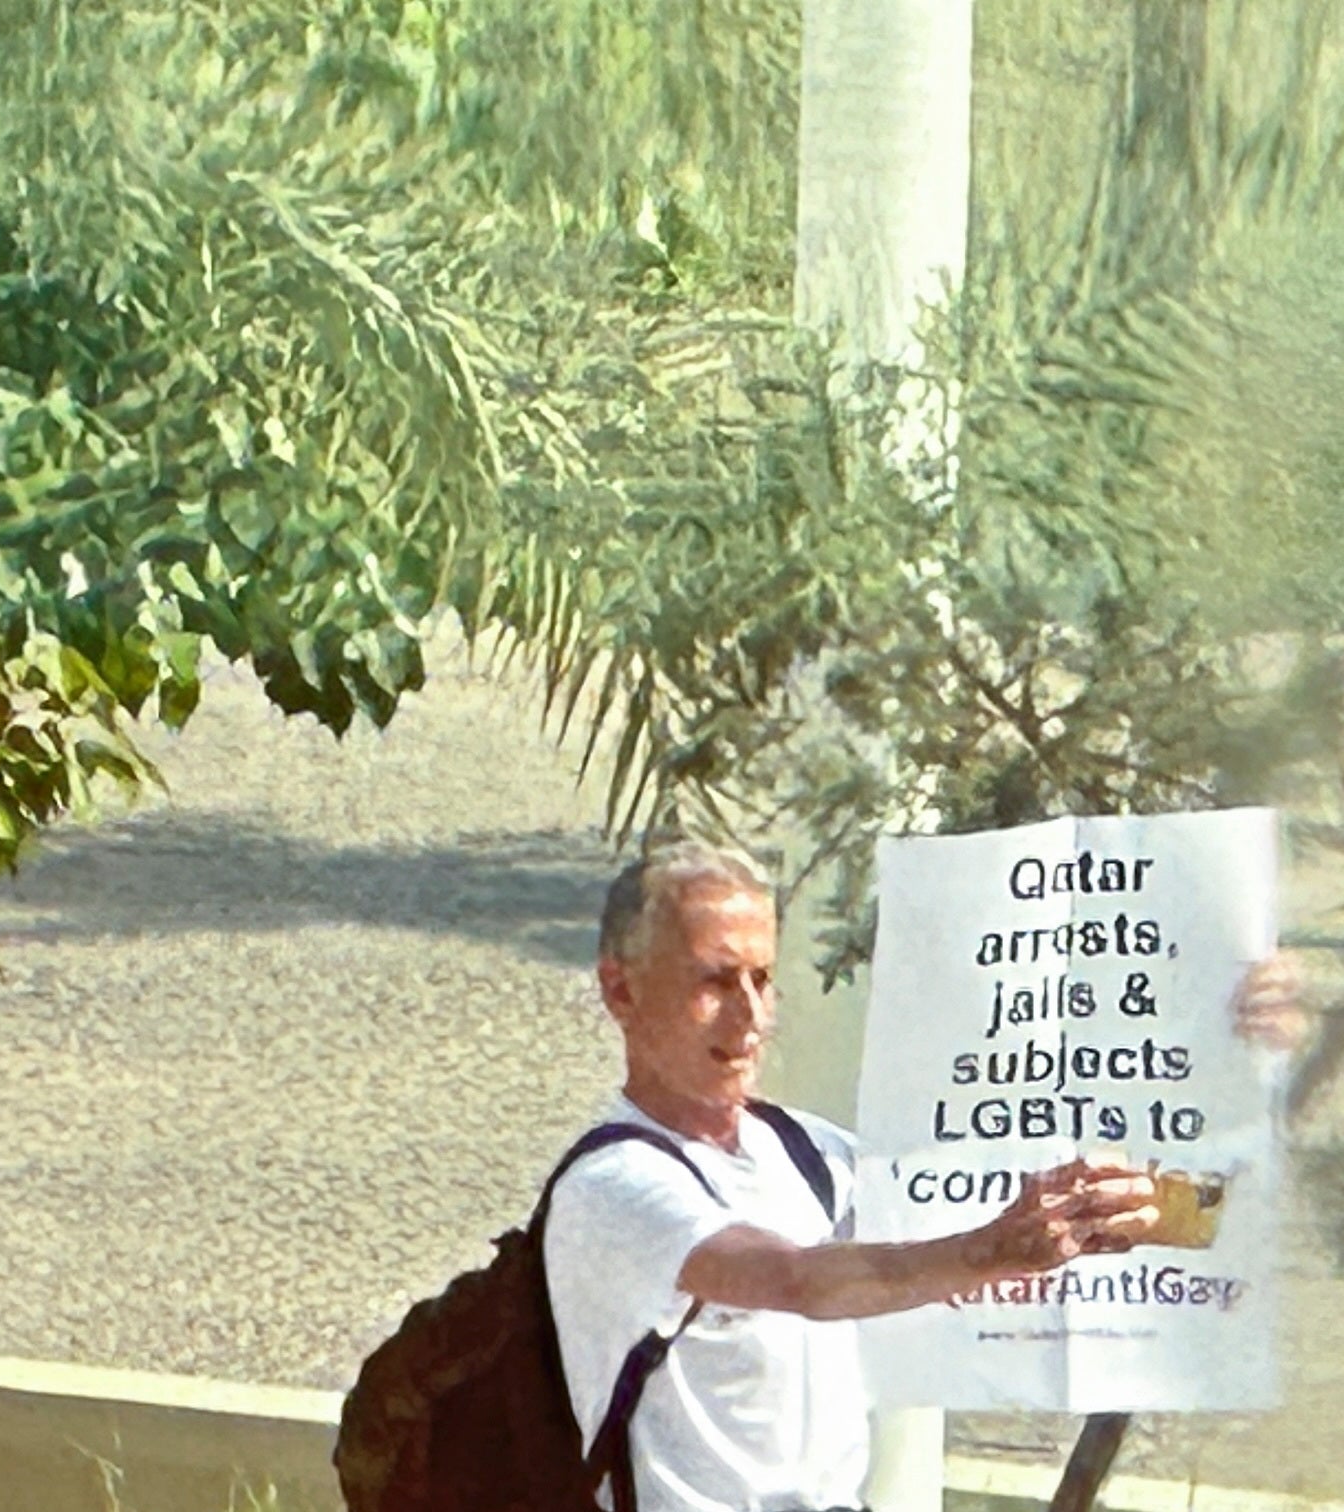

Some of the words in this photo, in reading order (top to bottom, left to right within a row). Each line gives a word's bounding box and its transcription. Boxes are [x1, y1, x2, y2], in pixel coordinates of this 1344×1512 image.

[1008, 850, 1154, 900] Qatar
[985, 973, 1097, 1039] jails
[1119, 972, 1158, 1017] &
[951, 1031, 1193, 1092] subjects
[933, 1096, 1128, 1142] LGBTs
[1148, 1100, 1206, 1142] to
